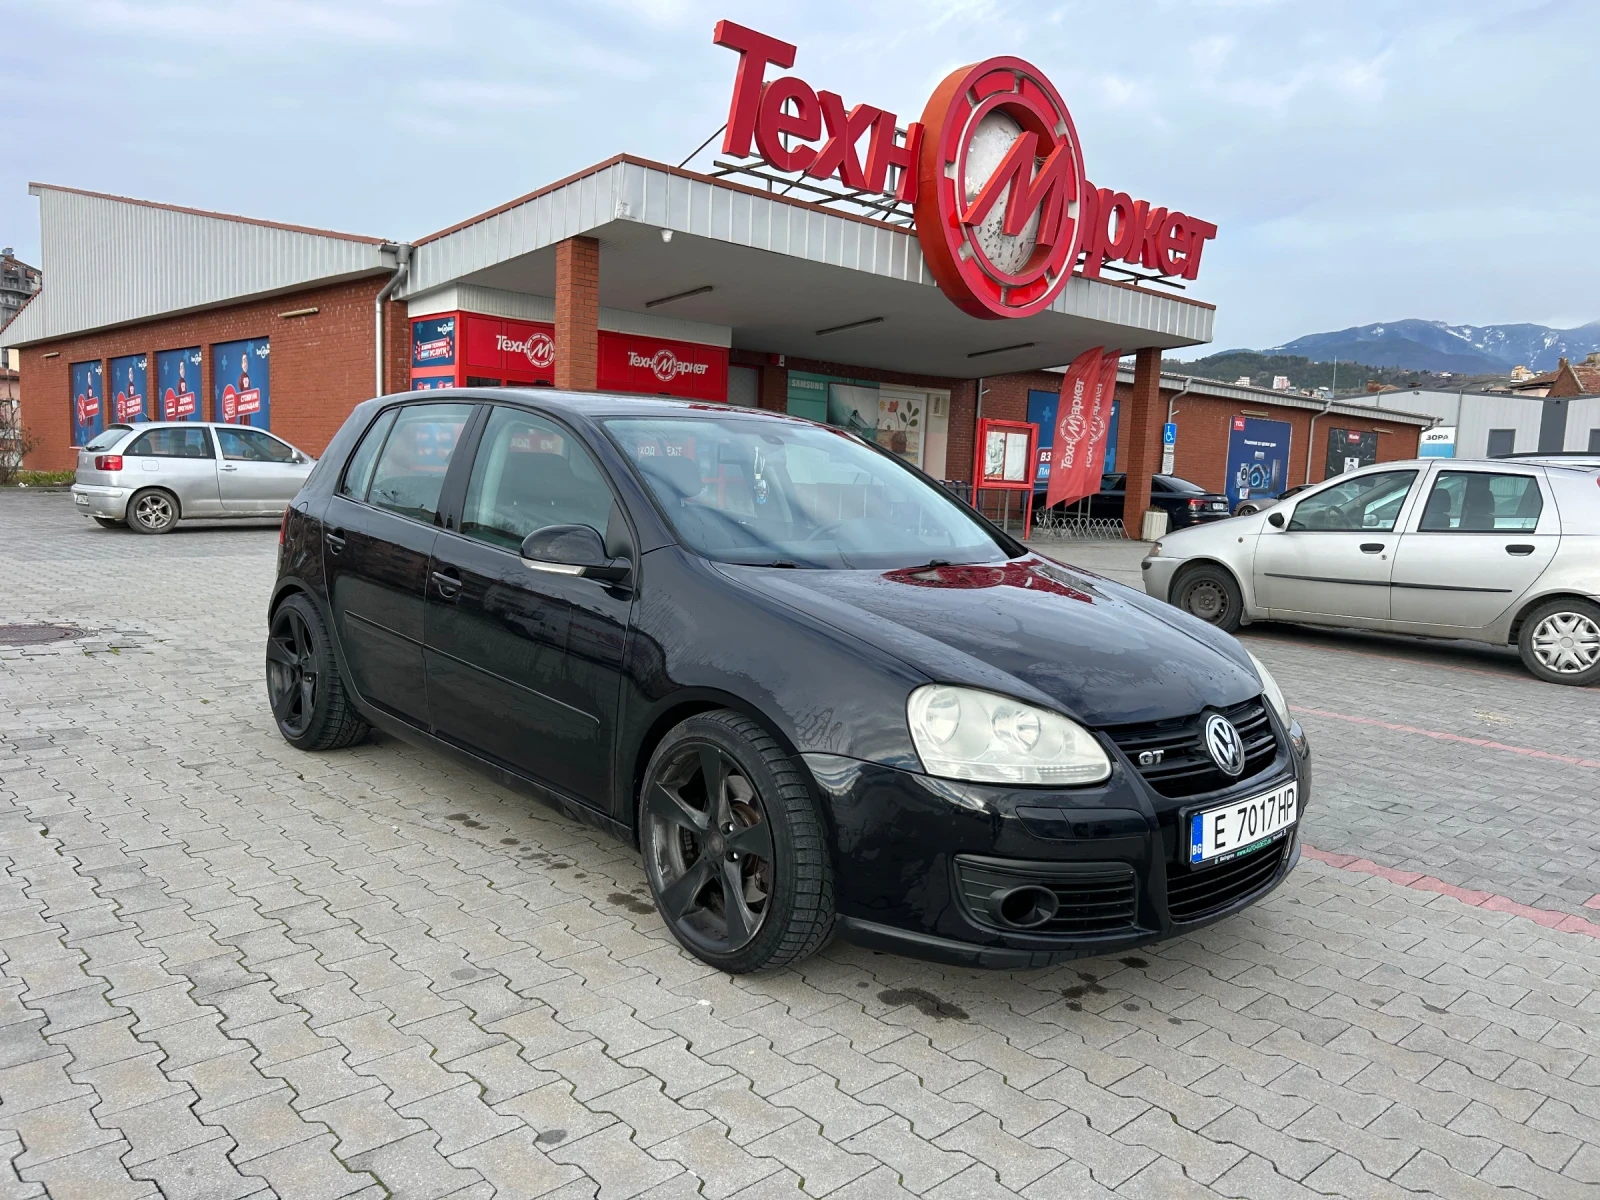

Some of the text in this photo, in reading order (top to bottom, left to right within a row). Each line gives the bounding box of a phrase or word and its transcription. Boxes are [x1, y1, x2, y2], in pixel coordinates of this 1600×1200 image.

[792, 379, 824, 391] SAMSUNG
[666, 446, 683, 457] EXIT
[1138, 750, 1165, 766] GT
[1214, 813, 1226, 850] E
[1192, 843, 1202, 856] BG
